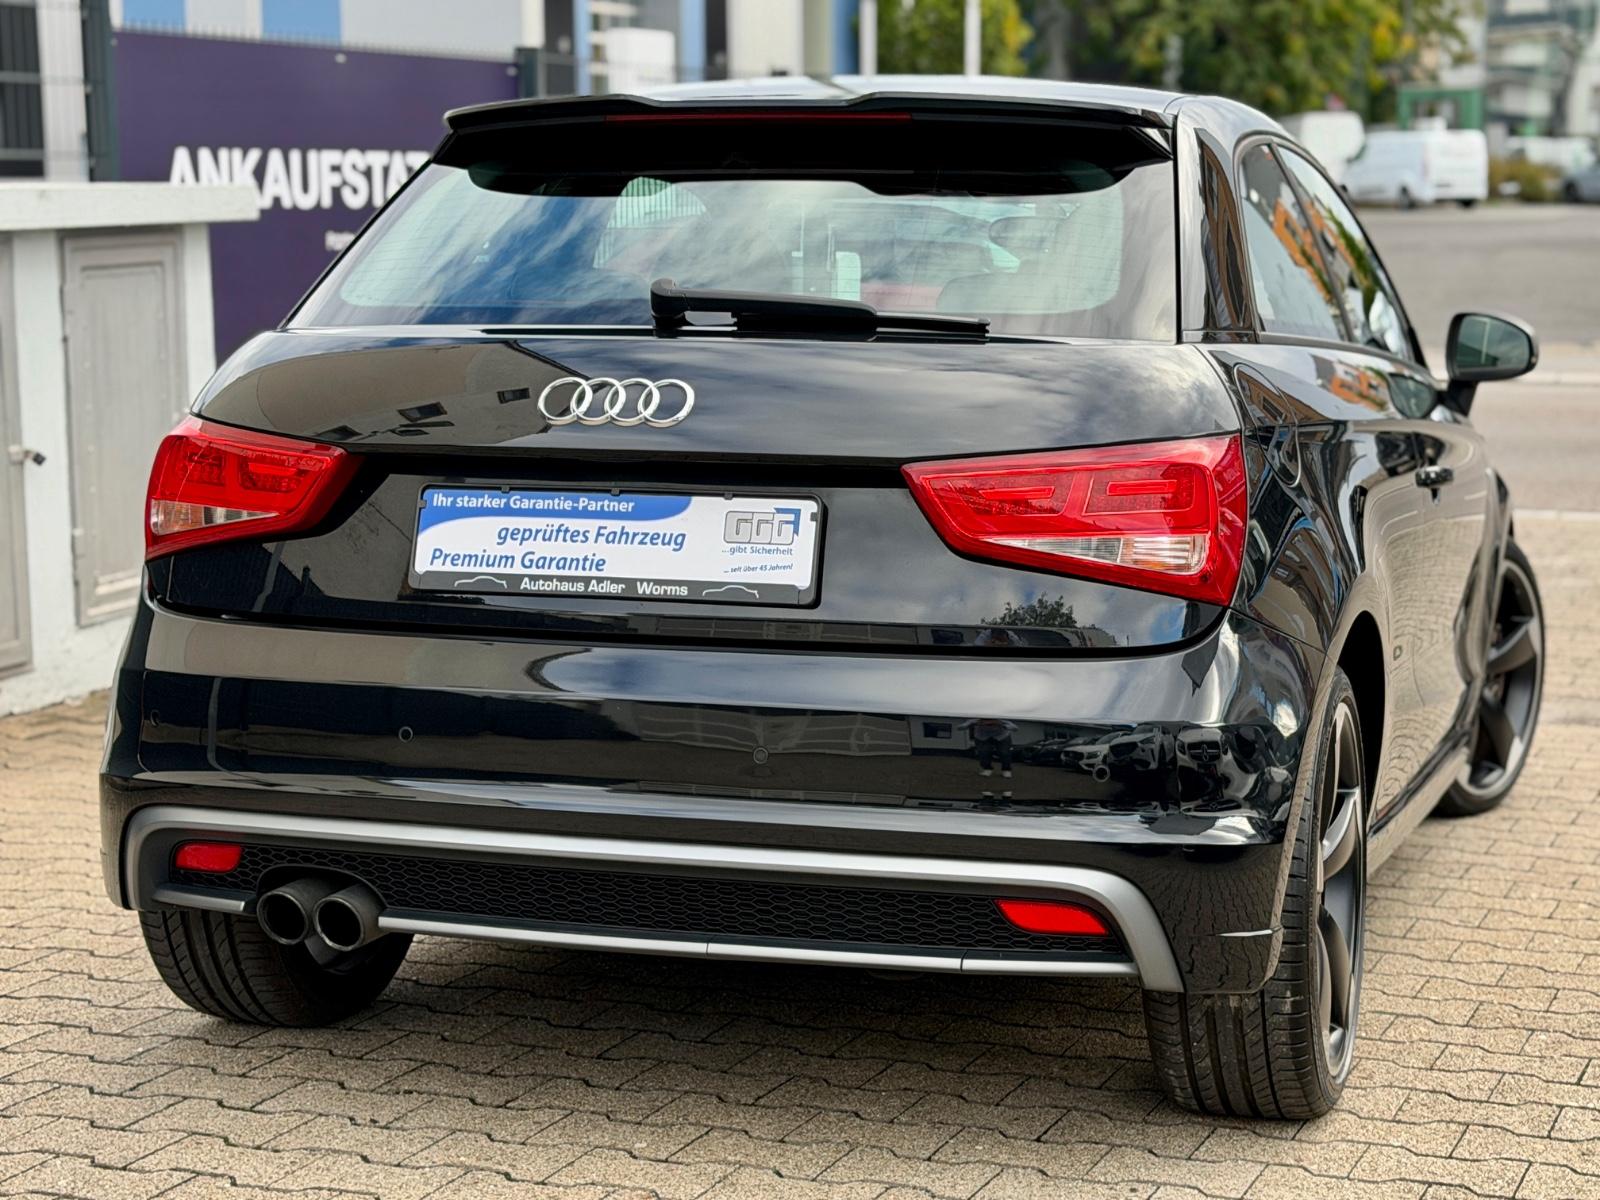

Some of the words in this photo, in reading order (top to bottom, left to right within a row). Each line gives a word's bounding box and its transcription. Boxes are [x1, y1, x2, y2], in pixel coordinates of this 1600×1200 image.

[432, 493, 453, 508] Ihr
[455, 494, 507, 509] starker
[509, 495, 635, 512] Garantie-Partner
[496, 523, 591, 546] geprüftes
[593, 525, 687, 552] Fahrzeug
[429, 548, 516, 569] Premium
[520, 551, 607, 572] Garantie
[749, 546, 793, 556] Sicherheit
[520, 577, 585, 592] Autohaus
[587, 579, 626, 593] Adler
[636, 581, 689, 596] Worms
